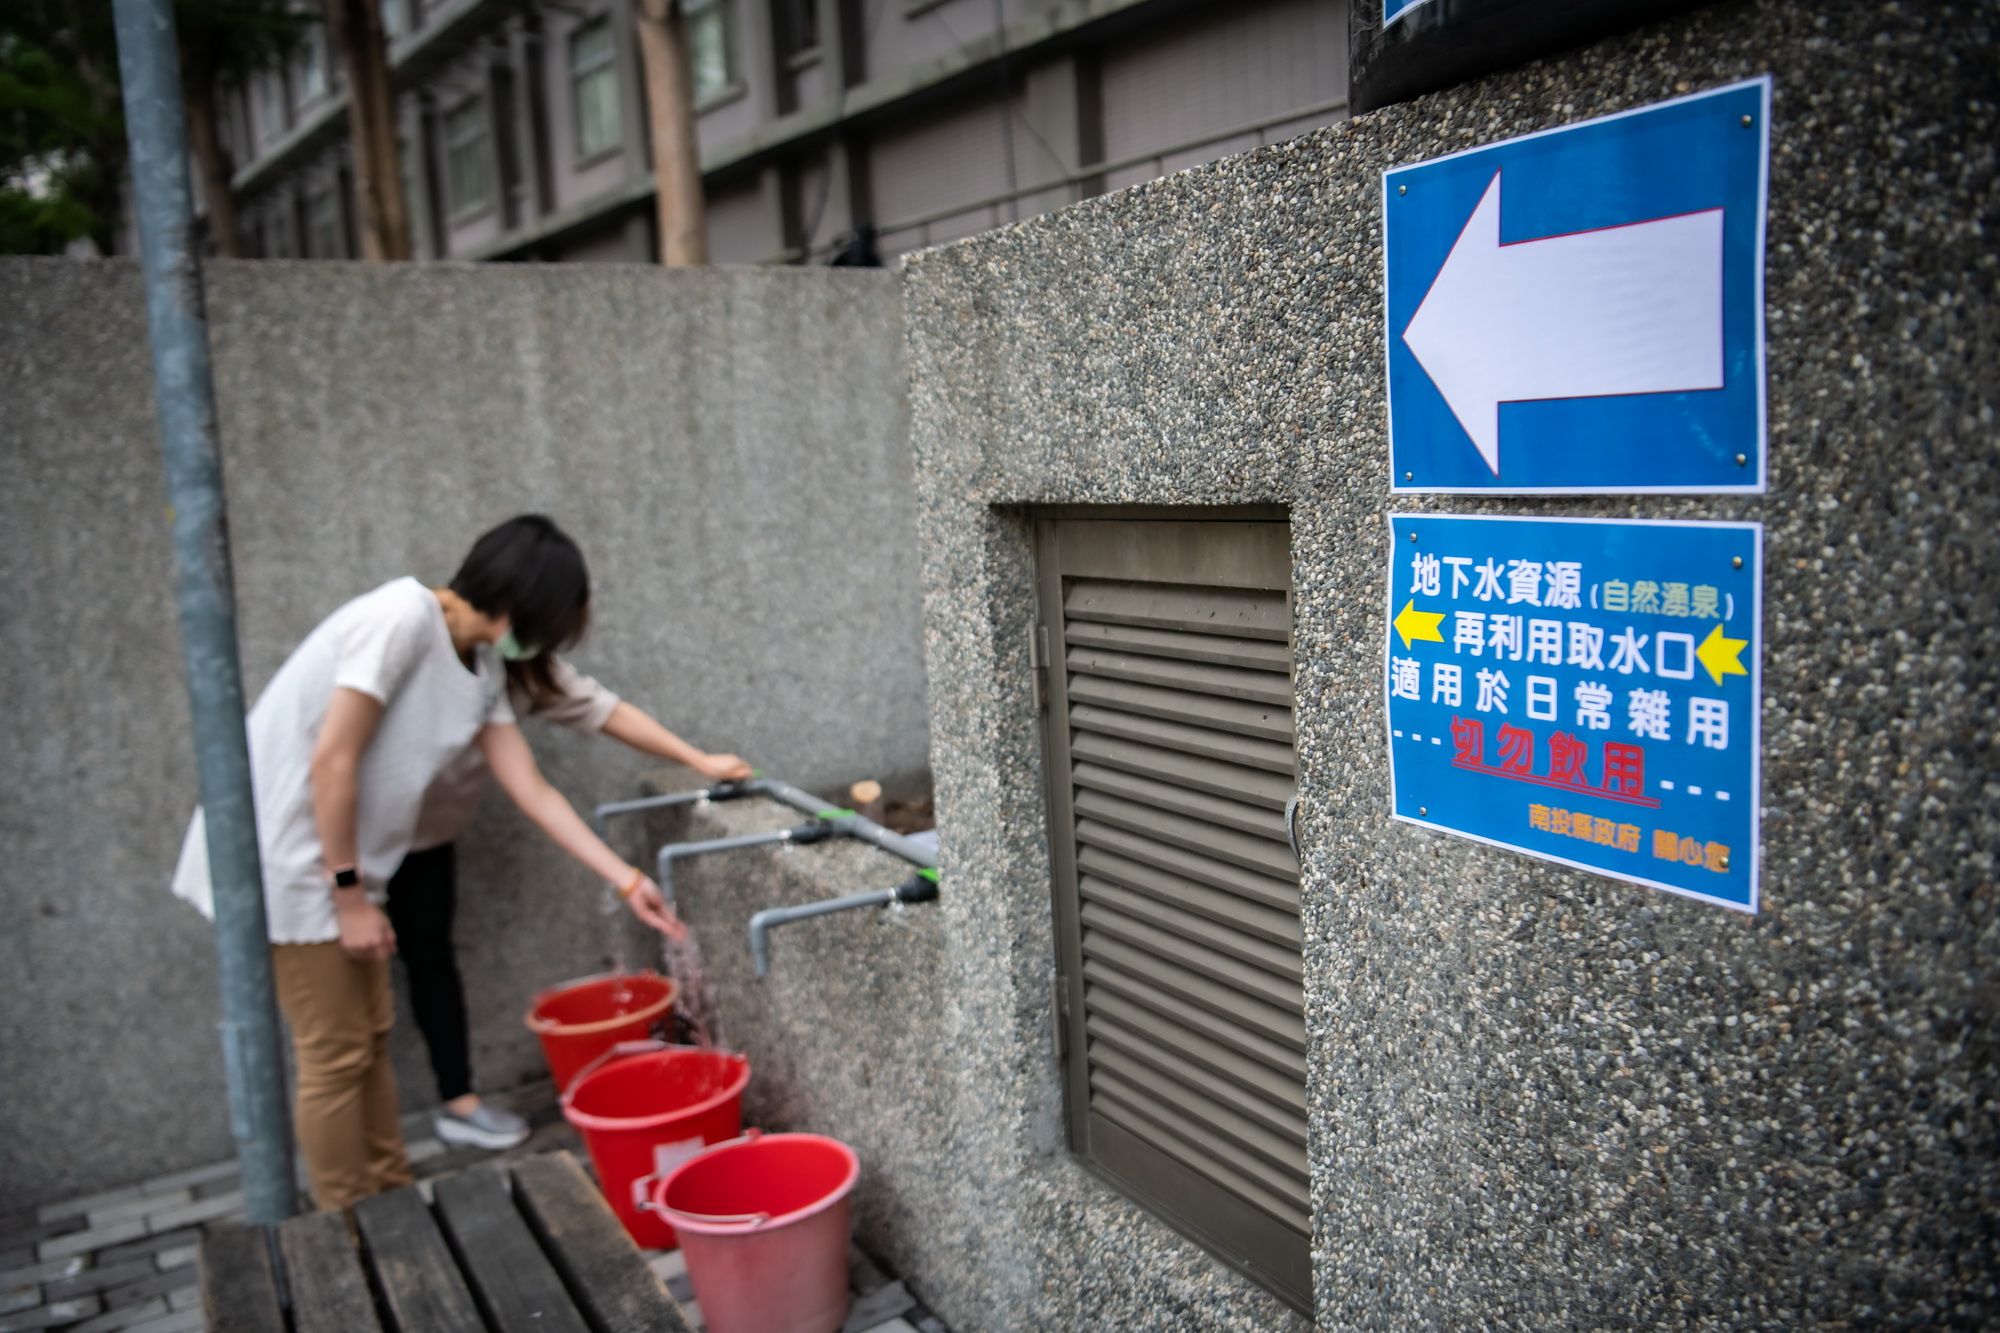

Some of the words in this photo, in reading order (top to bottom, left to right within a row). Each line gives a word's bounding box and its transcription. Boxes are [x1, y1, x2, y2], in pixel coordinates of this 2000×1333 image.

[1410, 552, 1582, 609] 地下水資源
[1453, 610, 1695, 681] 再利用取水口
[1390, 655, 1730, 750] 適用於日常雜用
[1528, 803, 1642, 853] 南投縣政府
